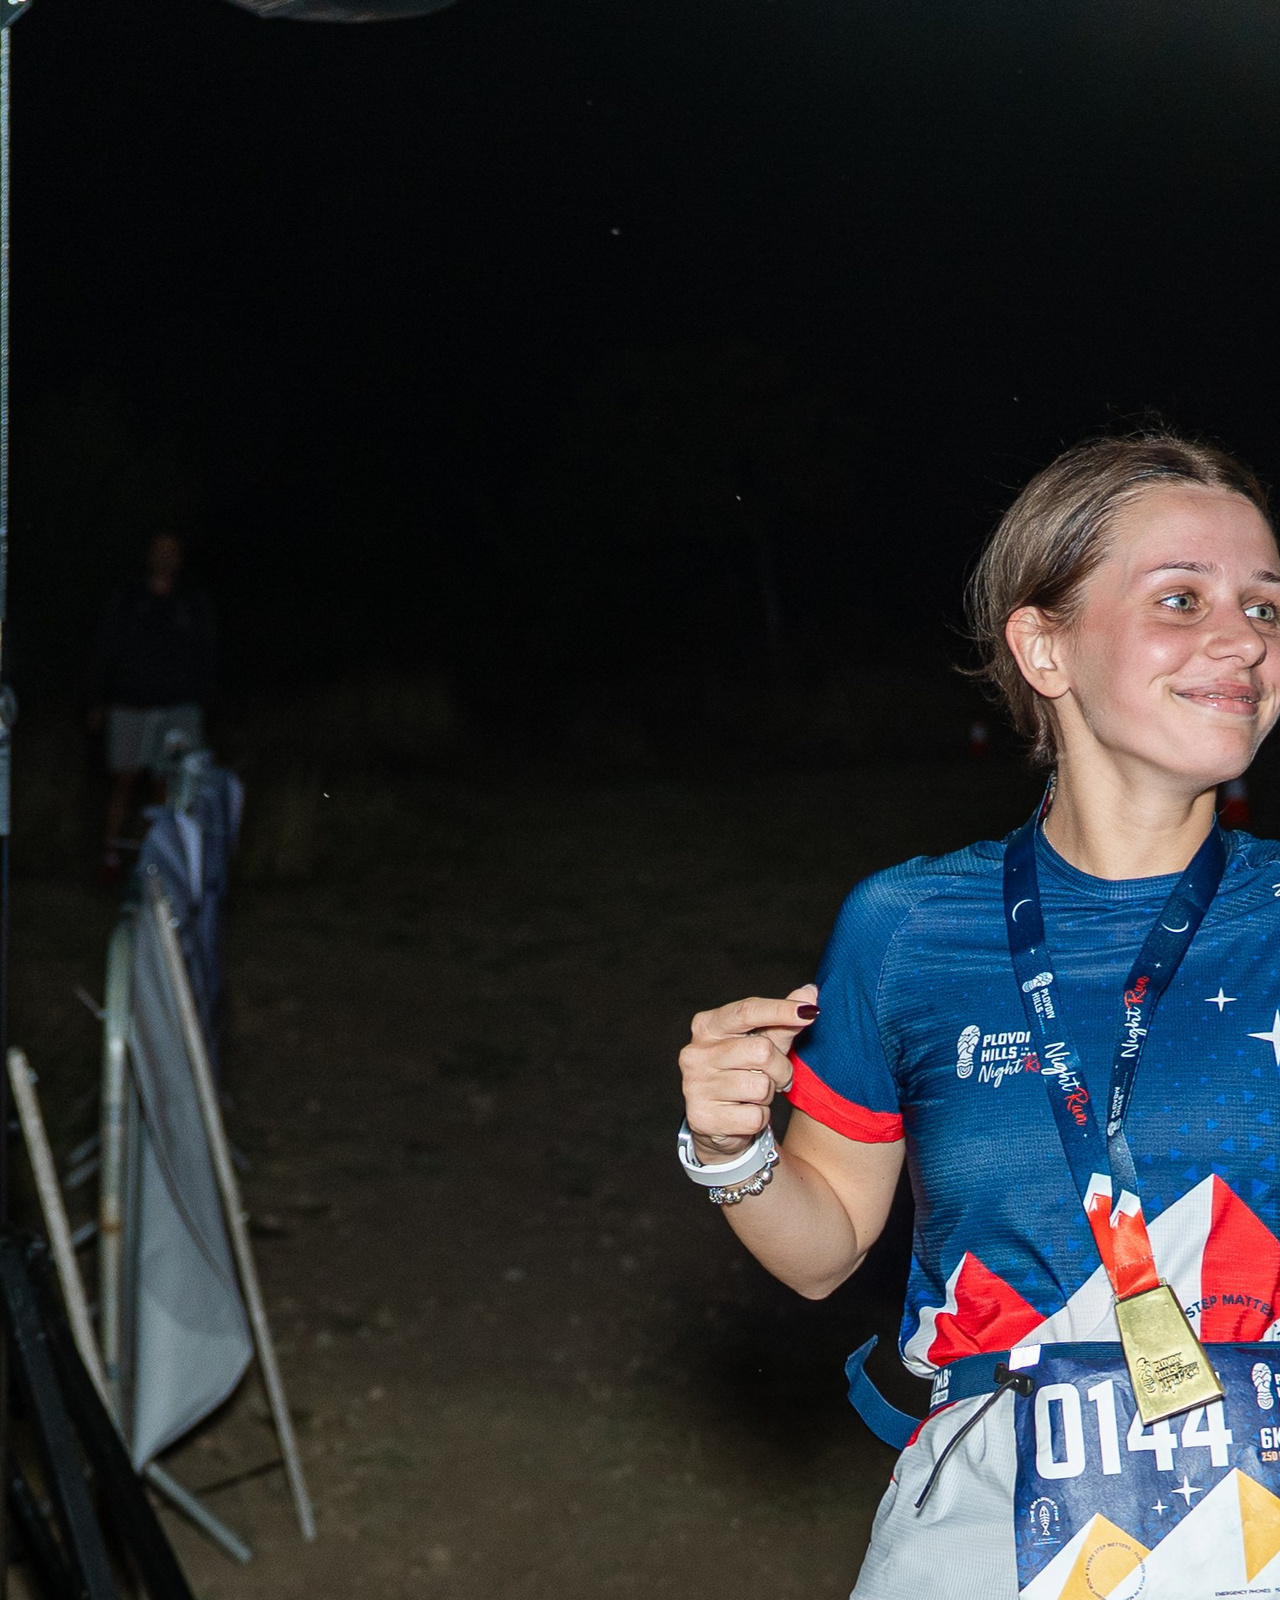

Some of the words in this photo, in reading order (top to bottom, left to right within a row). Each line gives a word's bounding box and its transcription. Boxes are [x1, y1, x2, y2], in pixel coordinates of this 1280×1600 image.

[1031, 992, 1044, 1013] HILLS
[1040, 988, 1056, 1019] PLOVDIV
[1124, 976, 1150, 1009] Run
[983, 1031, 1031, 1047] PLOVDI
[1121, 1006, 1147, 1058] Night
[981, 1046, 1017, 1062] HILLS
[978, 1058, 1024, 1088] Night
[1041, 1041, 1080, 1092] Night
[1065, 1087, 1089, 1126] Run
[1186, 1295, 1217, 1318] STEP
[1035, 1372, 1233, 1480] 0144
[1262, 1451, 1277, 1462] 250
